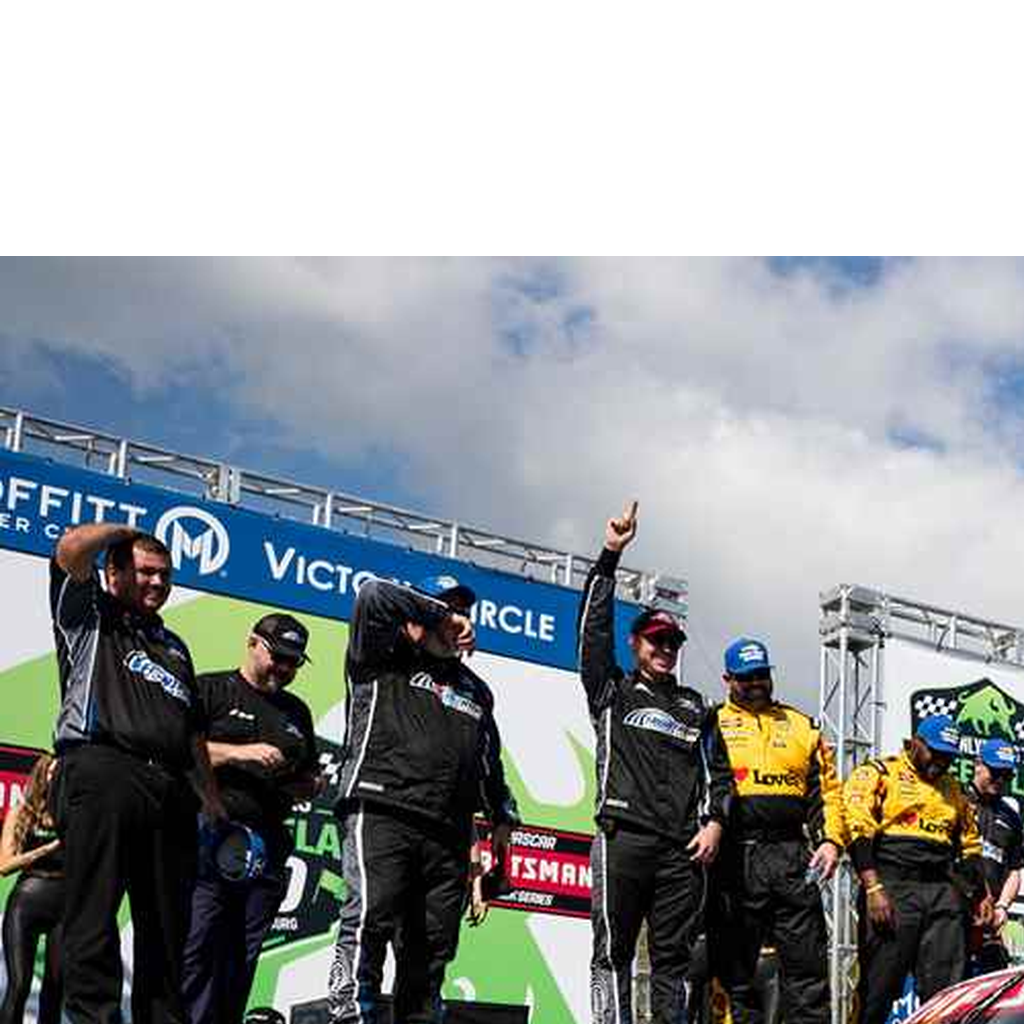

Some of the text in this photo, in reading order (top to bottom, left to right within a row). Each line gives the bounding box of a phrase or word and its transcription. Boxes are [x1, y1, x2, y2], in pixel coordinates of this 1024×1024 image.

[0, 476, 147, 530] FFITT
[264, 542, 555, 642] VICTO IRCLE
